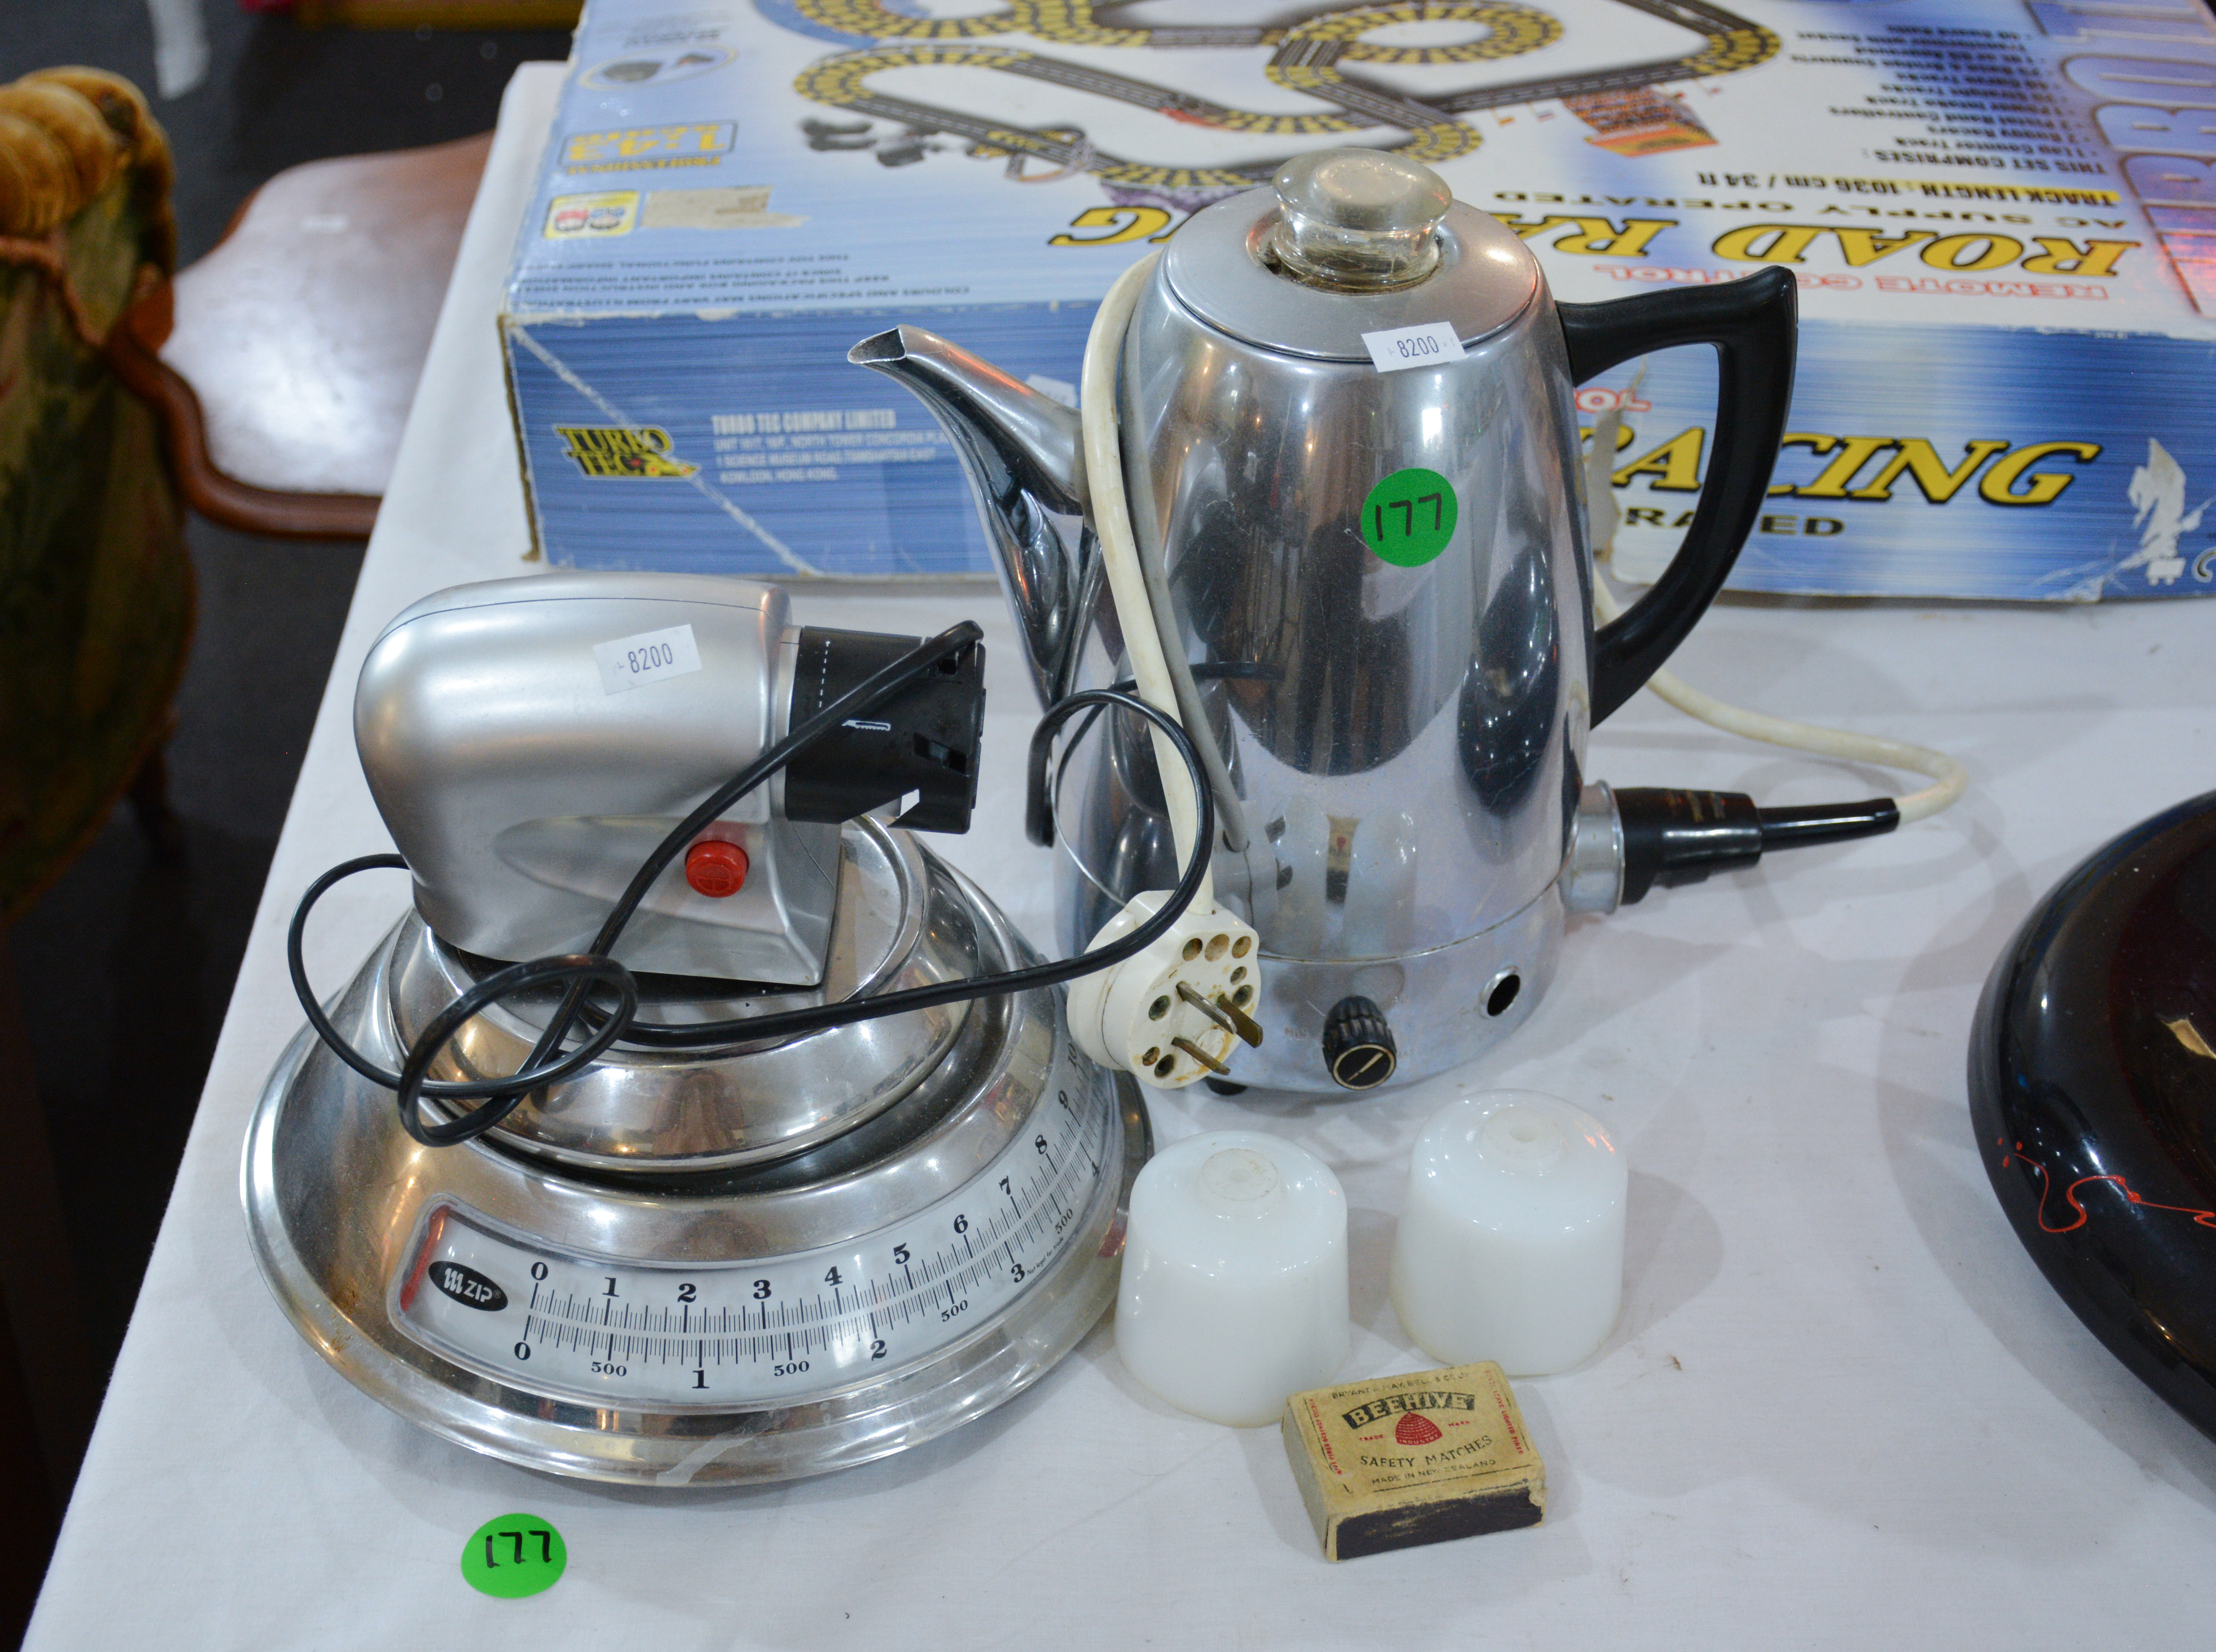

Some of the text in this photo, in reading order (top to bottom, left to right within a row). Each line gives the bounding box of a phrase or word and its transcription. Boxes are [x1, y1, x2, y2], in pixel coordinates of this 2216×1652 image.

[1866, 94, 1919, 108] Track
[1829, 106, 1940, 122] Controllers
[1894, 137, 1949, 150] Track
[1926, 126, 1996, 138] Racers
[1956, 142, 2034, 154] Counter
[1875, 150, 2106, 174] THIS SET COMPRISES
[1697, 173, 1717, 187] ft
[1725, 174, 1757, 188] 34
[1785, 175, 1826, 189] cm
[1834, 179, 1899, 196] 1036
[1919, 183, 2019, 204] LENGTH
[2029, 188, 2116, 207] TRACK
[1493, 191, 2126, 230] AC SUPPLY OPERATED
[1712, 224, 2141, 277] ROAD
[1593, 264, 2107, 301] REMOTE COTROL
[1396, 335, 1440, 358] 8200
[844, 408, 897, 431] LIMITED
[557, 427, 671, 454] TURBO
[1375, 491, 1443, 542] 177
[628, 643, 673, 674] 8200
[531, 1262, 549, 1282] 0
[602, 1277, 621, 1298] 1
[677, 1283, 697, 1303] 2
[753, 1279, 772, 1300] 3
[824, 1265, 843, 1288] 4
[892, 1242, 912, 1265] 5
[953, 1214, 969, 1235] 6
[998, 1175, 1013, 1196] 7
[1035, 1134, 1048, 1155] 8
[1058, 1090, 1068, 1109] 9
[1027, 1266, 1036, 1276] Not
[1036, 1255, 1046, 1267] legal
[1053, 1236, 1064, 1250] trade
[463, 1280, 493, 1302] ZIP
[514, 1341, 531, 1361] 0
[590, 1361, 627, 1378] 500
[692, 1370, 711, 1389] 1
[773, 1361, 811, 1377] 500
[870, 1339, 888, 1361] 2
[941, 1300, 969, 1323] 500
[1011, 1263, 1025, 1283] 3
[1055, 1208, 1073, 1234] 500
[1347, 1392, 1470, 1426] BEEHIVE
[1399, 1434, 1439, 1445] INDUSTRY
[1501, 1410, 1515, 1435] LIGHTED
[1511, 1436, 1524, 1455] FIRES
[1360, 1435, 1493, 1468] SAFETY MATCHES
[1372, 1475, 1400, 1485] MADE
[1443, 1459, 1497, 1472] ZEALAND
[485, 1530, 553, 1569] 177
